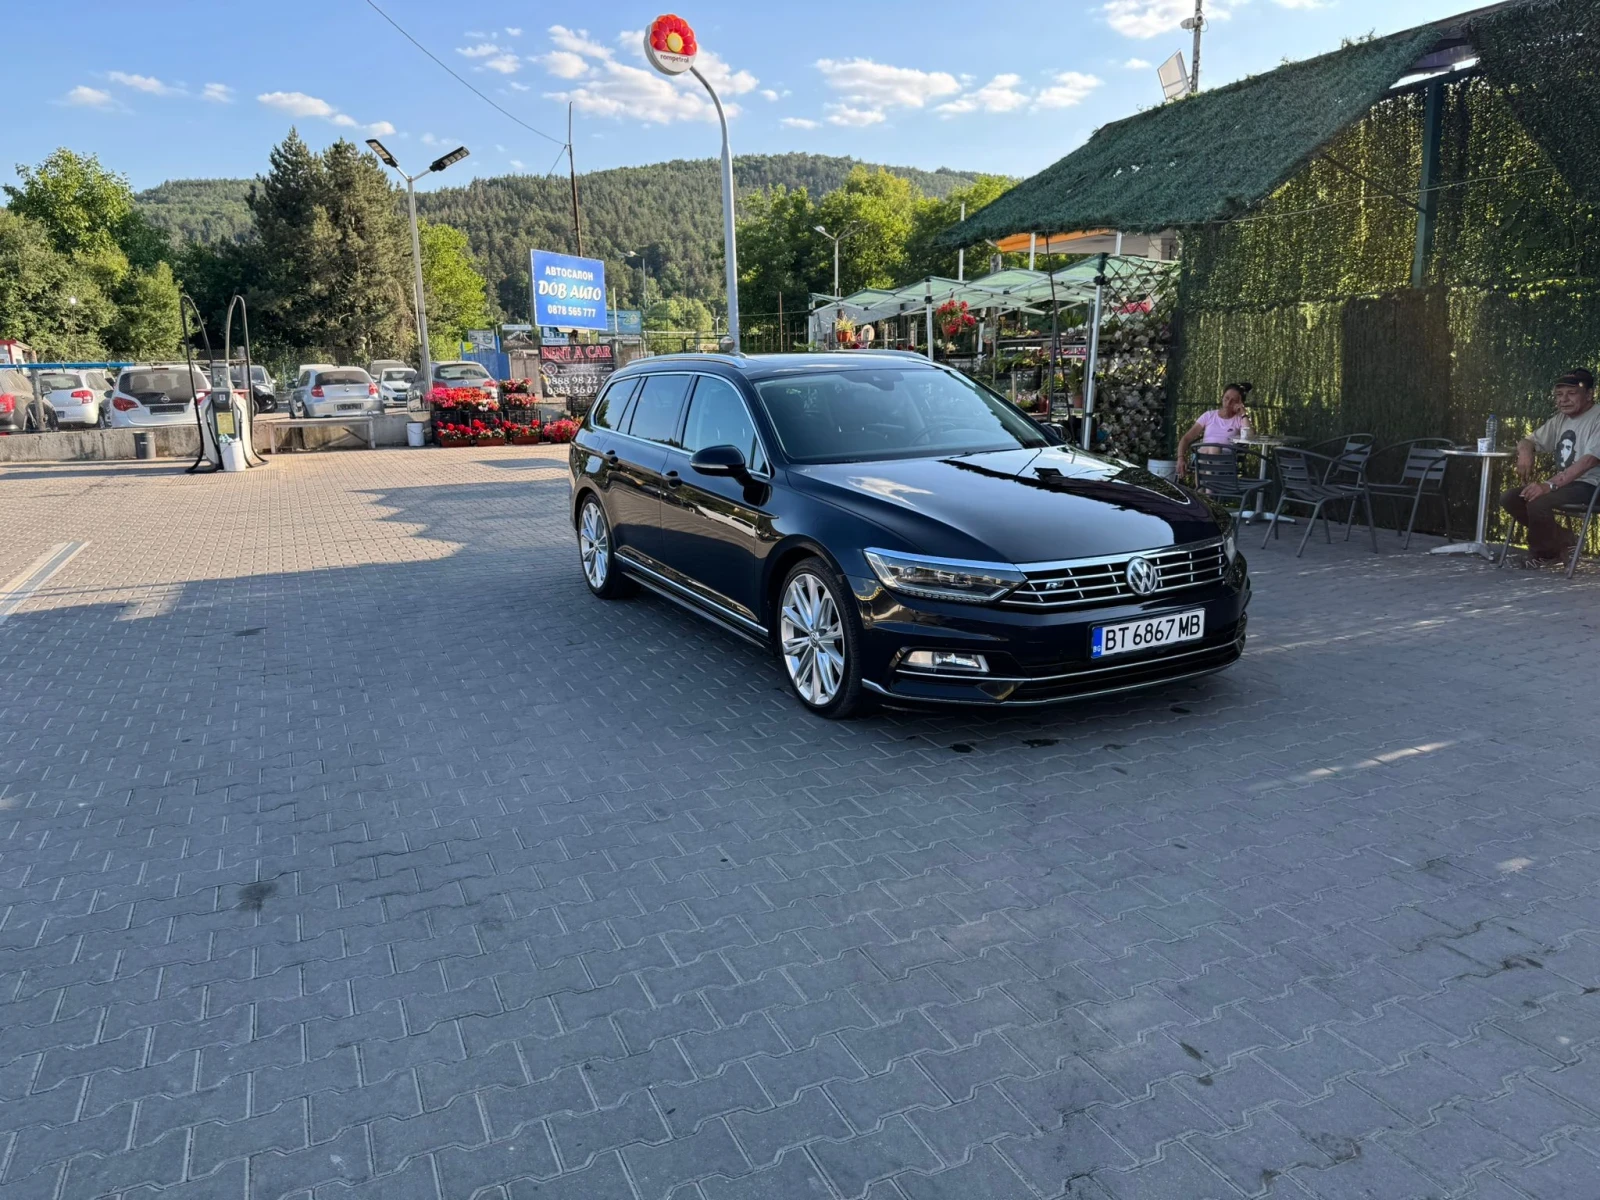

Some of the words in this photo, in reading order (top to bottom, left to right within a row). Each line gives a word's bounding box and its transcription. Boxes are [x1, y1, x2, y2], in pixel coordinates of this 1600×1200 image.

[545, 266, 593, 280] АВТОСАЛОН
[538, 280, 567, 299] DOB
[547, 304, 567, 315] 0878
[583, 308, 596, 317] 777
[541, 347, 571, 359] RENT
[574, 347, 584, 358] A
[586, 346, 612, 358] CAR
[571, 376, 584, 384] 98
[586, 376, 598, 384] 22
[573, 386, 586, 394] 36
[1105, 627, 1129, 650] BT
[1133, 619, 1175, 645] 6867
[1178, 615, 1200, 637] MB
